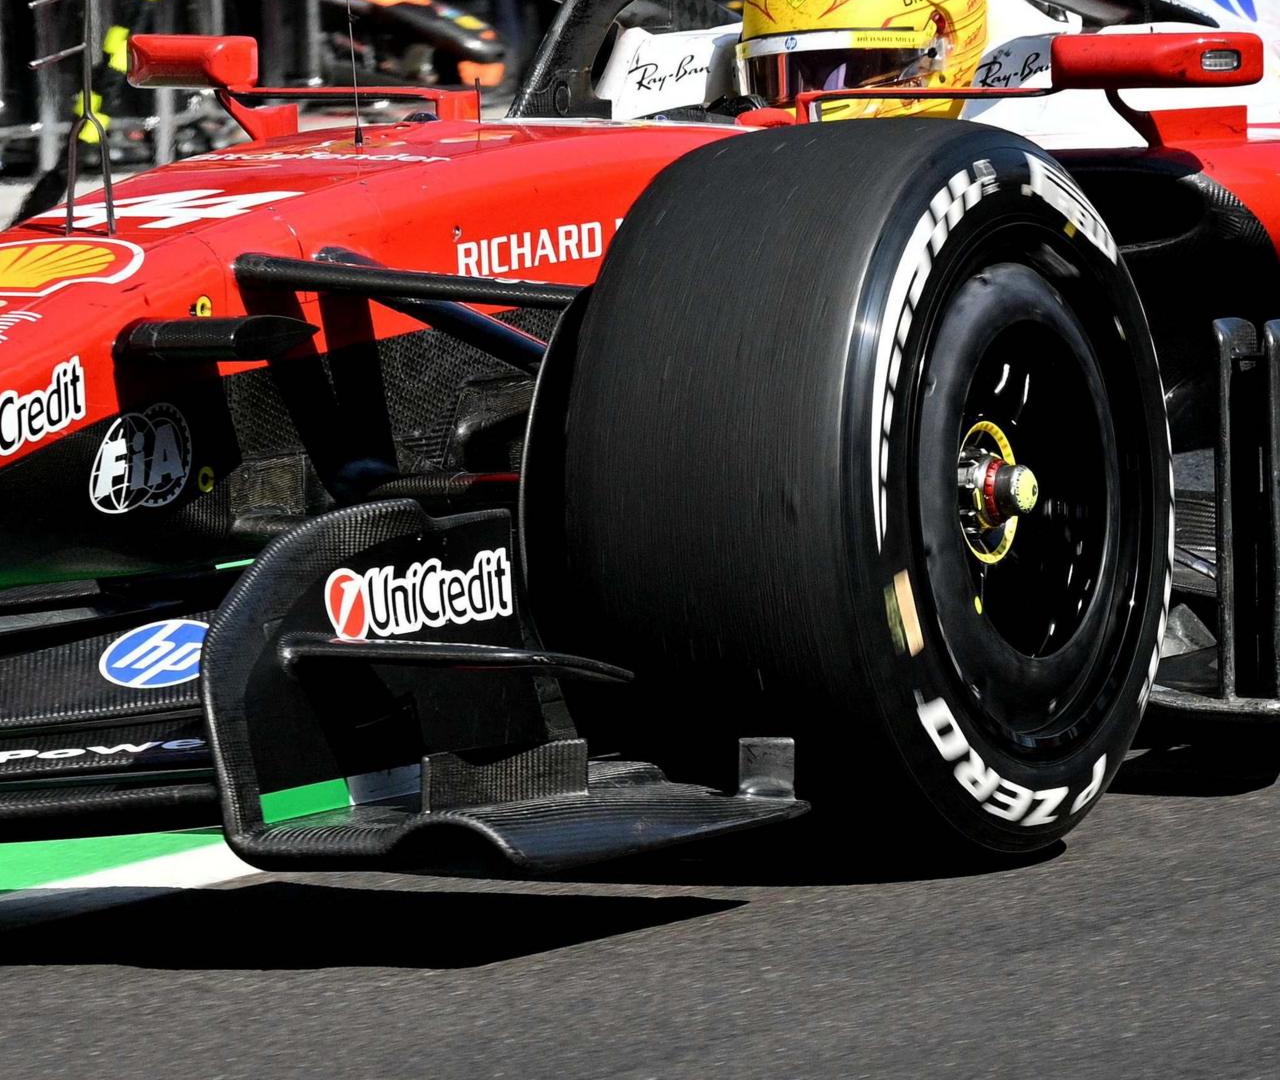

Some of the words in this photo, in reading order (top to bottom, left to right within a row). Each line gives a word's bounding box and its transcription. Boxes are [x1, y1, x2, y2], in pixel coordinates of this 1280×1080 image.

[627, 54, 712, 91] Ray-Ban
[457, 221, 603, 277] RICHARD
[367, 554, 509, 630] UniCredit
[106, 620, 204, 688] hp
[915, 696, 1070, 827] ZERO
